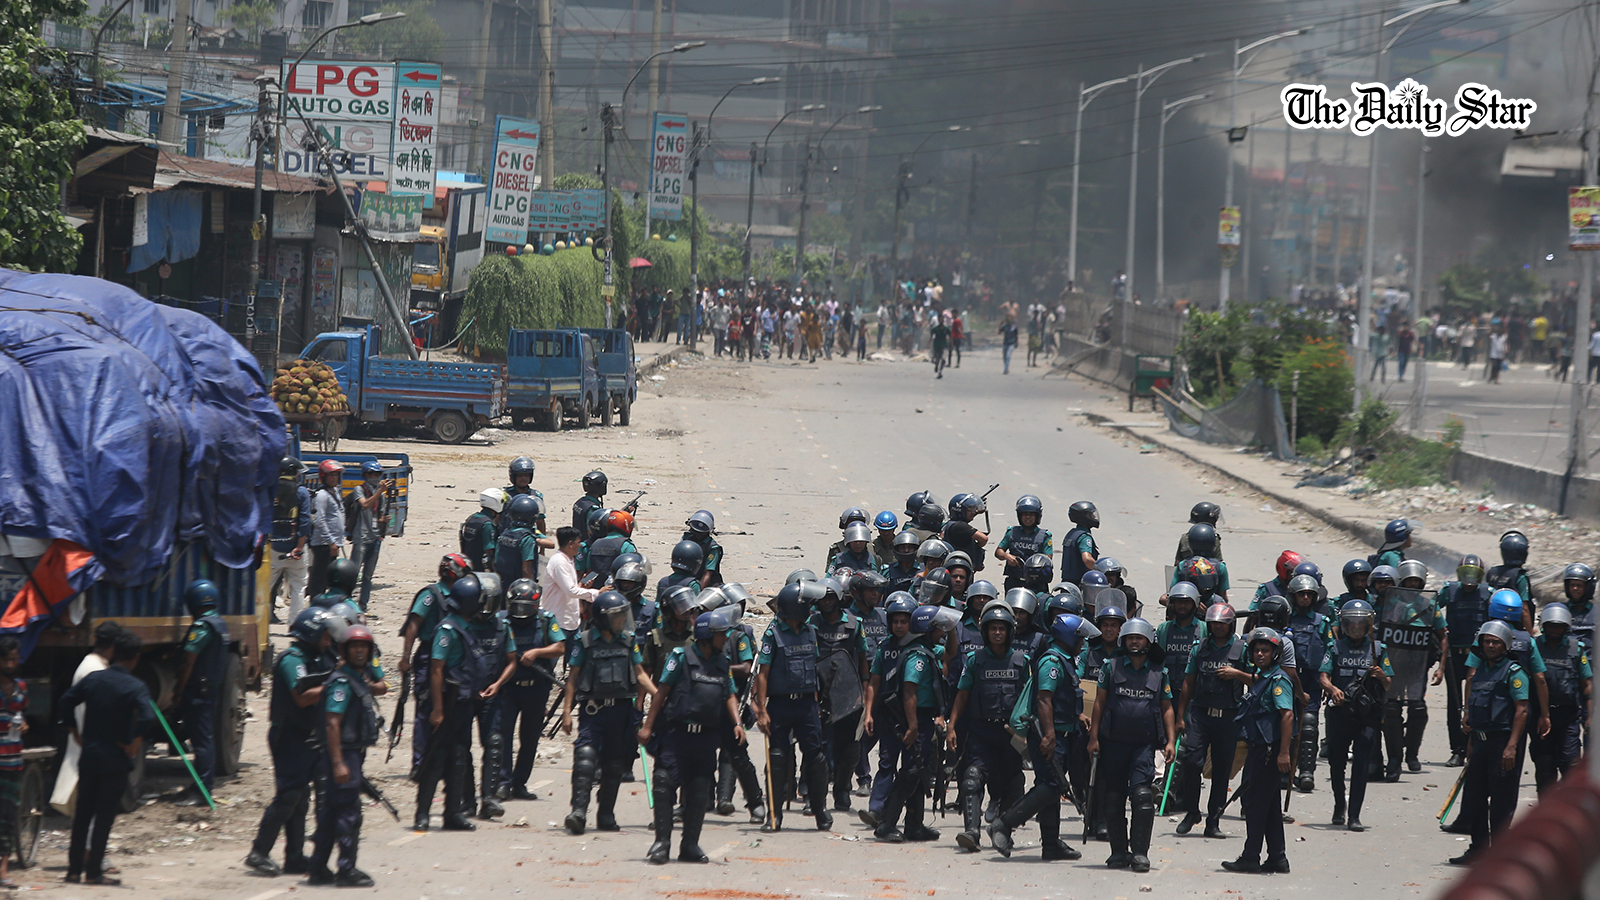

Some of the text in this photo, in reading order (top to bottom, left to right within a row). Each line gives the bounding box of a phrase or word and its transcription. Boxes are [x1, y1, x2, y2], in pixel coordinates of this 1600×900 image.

[286, 64, 379, 97] LPG
[288, 97, 389, 115] AUTO GAS
[285, 123, 374, 154] CNG
[656, 134, 684, 153] CNG
[284, 151, 384, 175] DIESEL
[498, 151, 534, 171] CNG
[655, 155, 682, 174] DIESEL
[496, 172, 530, 192] DIESEL
[655, 177, 680, 194] LPG
[494, 193, 527, 213] LPG
[530, 203, 547, 213] ESEL
[654, 195, 668, 203] AUTO
[492, 214, 510, 225] AUTO
[511, 216, 525, 227] GAS
[1014, 541, 1036, 550] POLICE
[864, 626, 884, 634] OLICE
[1383, 627, 1430, 646] POLICE
[1167, 643, 1192, 652] POLICE
[1342, 657, 1371, 667] POLICE
[1119, 687, 1151, 698] POLICE
